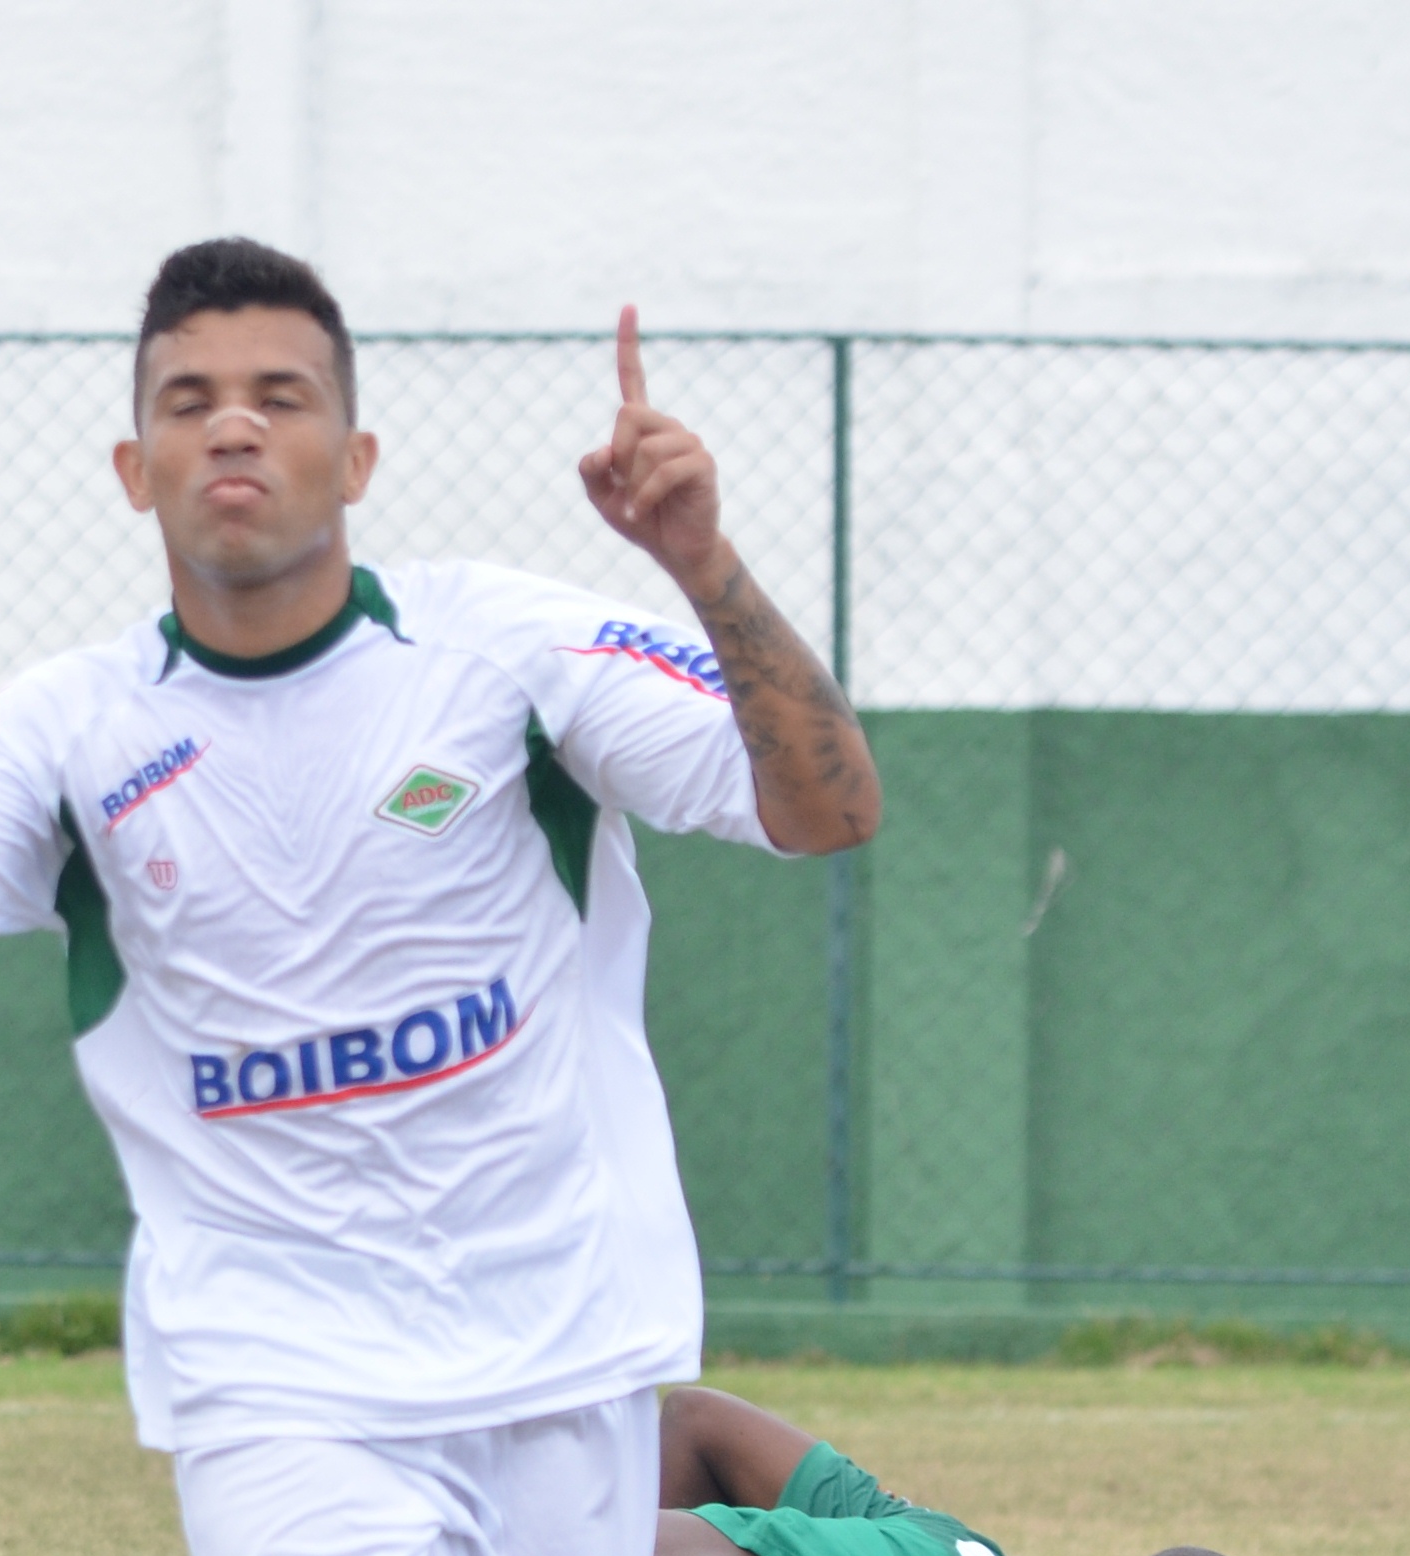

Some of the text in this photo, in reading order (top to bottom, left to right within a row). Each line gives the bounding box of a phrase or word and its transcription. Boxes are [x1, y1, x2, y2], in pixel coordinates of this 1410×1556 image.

[101, 737, 198, 820] BOIBOM
[402, 783, 453, 810] ADC
[191, 977, 519, 1112] BOIBOM
